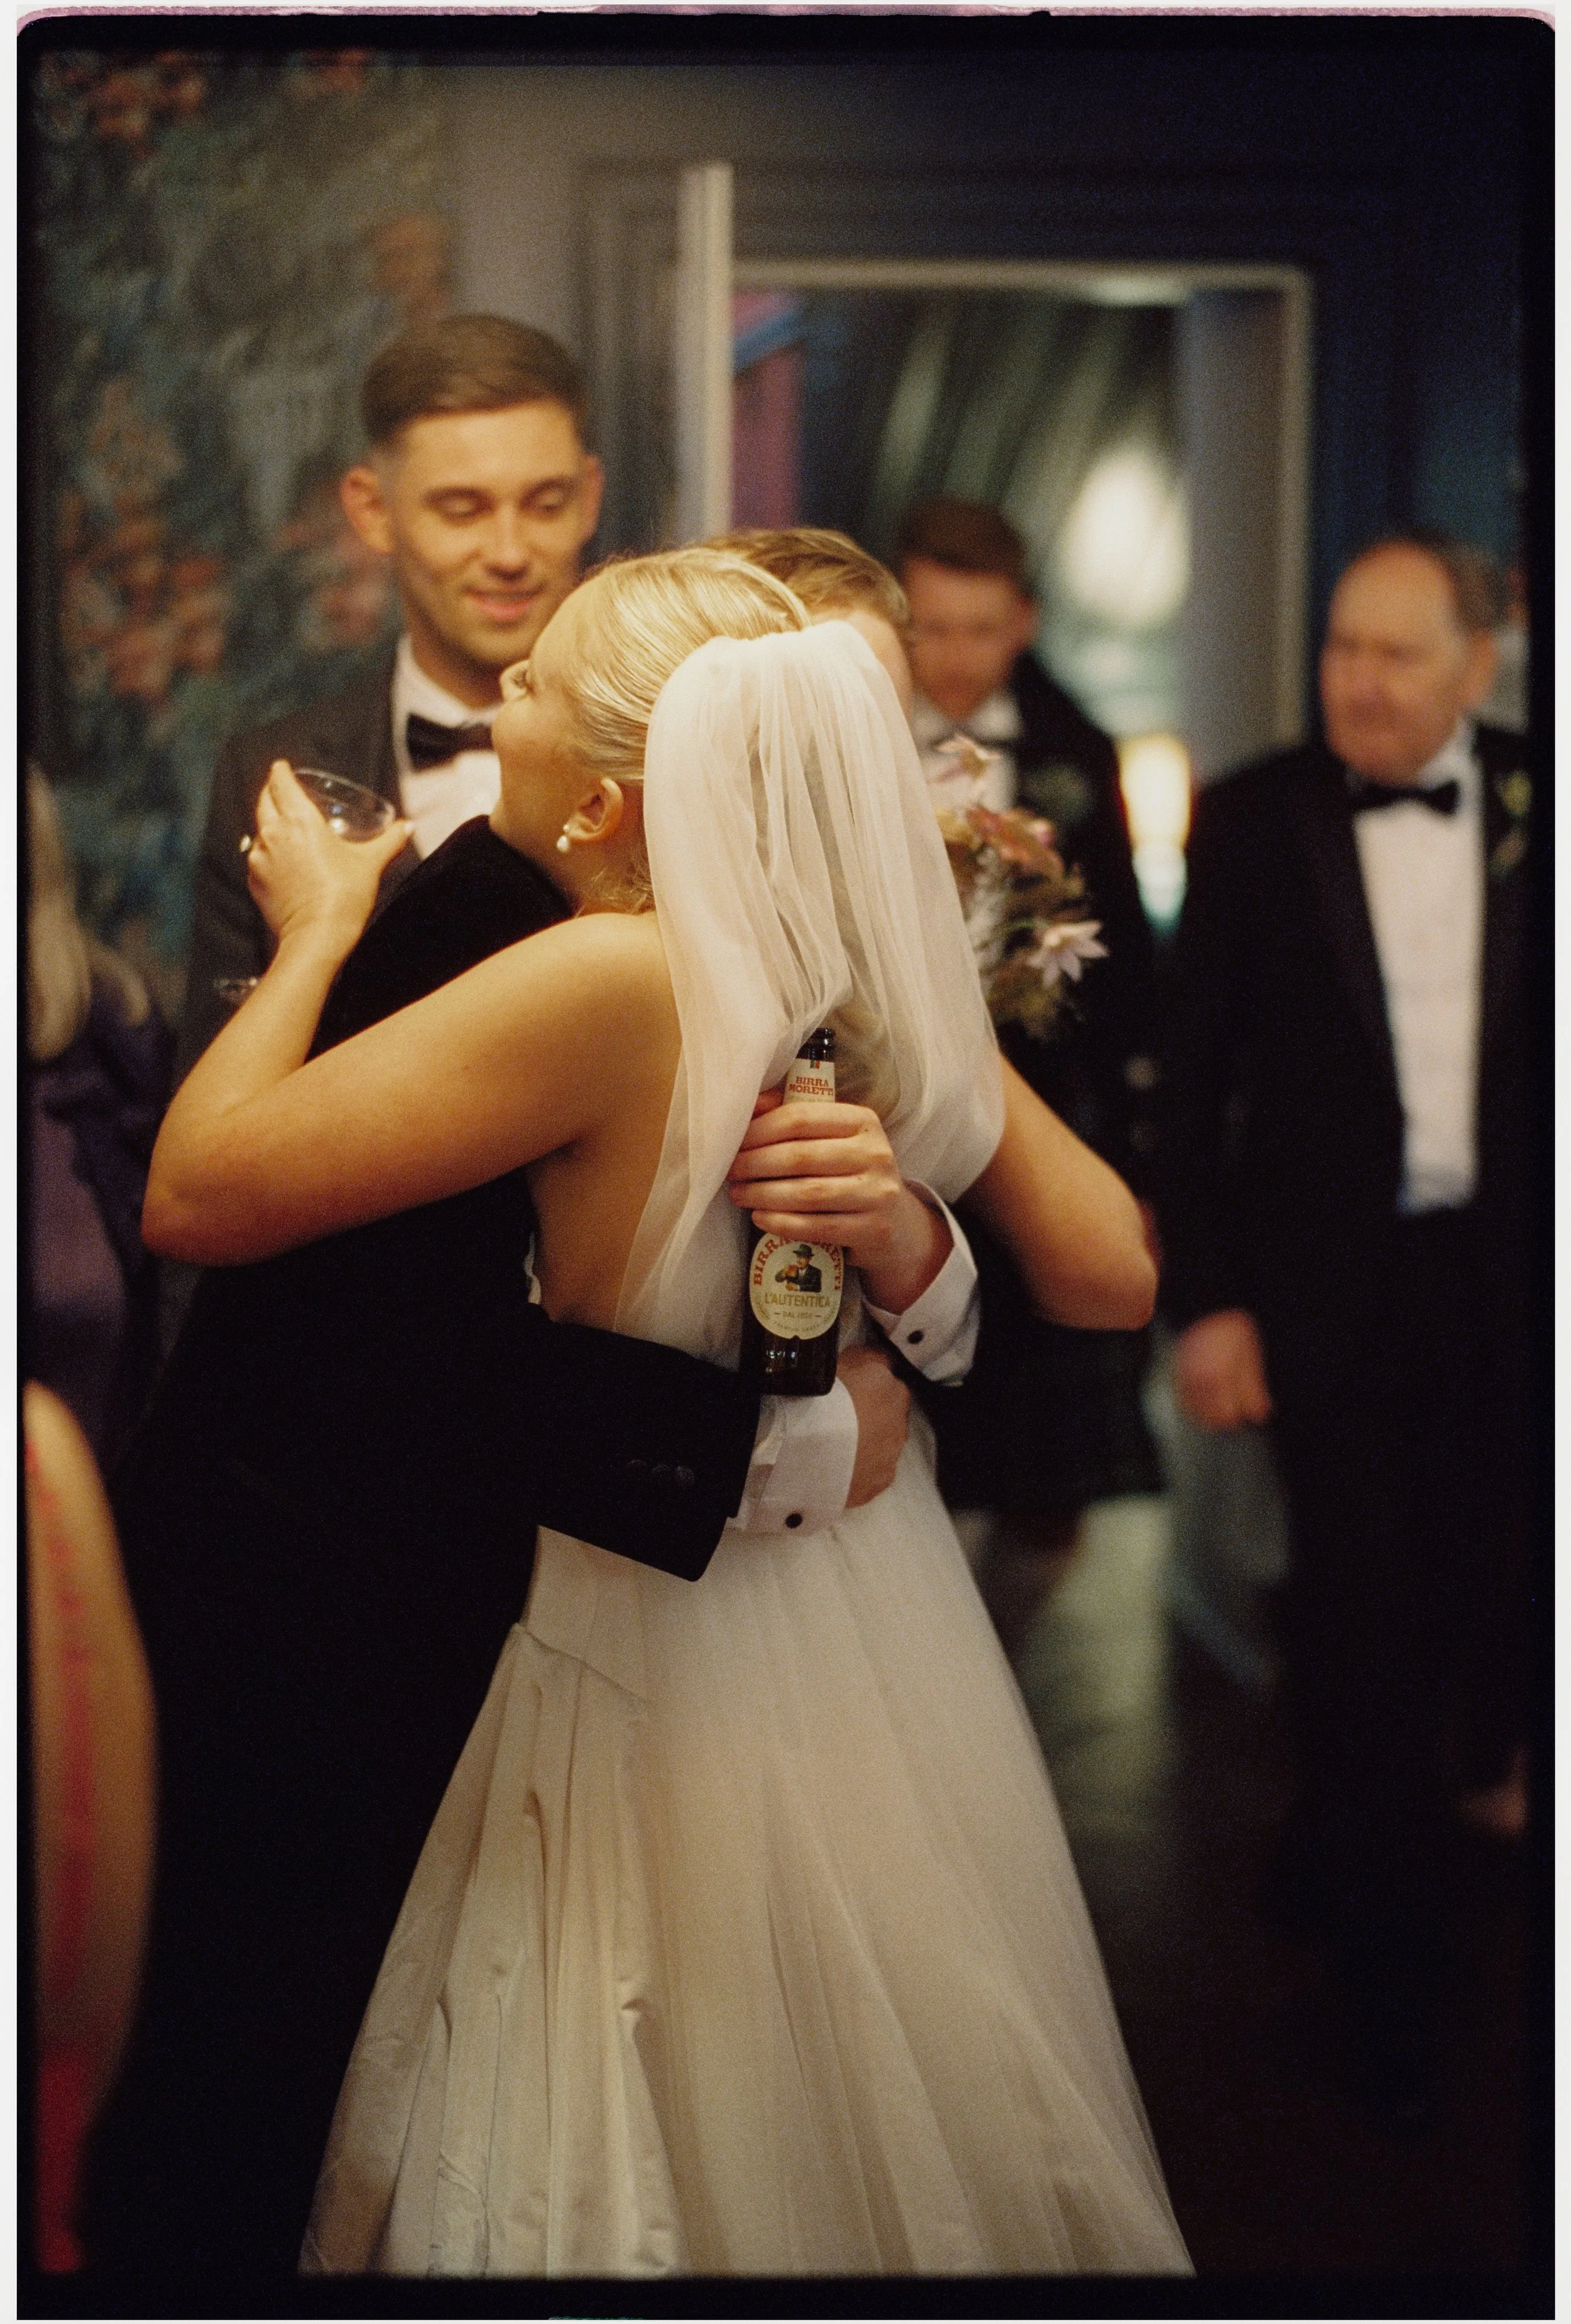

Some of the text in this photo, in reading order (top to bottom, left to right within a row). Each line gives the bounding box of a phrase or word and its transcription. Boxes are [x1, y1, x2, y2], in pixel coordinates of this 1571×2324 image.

[796, 1076, 829, 1087] BIRRA
[788, 1083, 833, 1095] MORETTI
[764, 1291, 831, 1307] L'AUTENTICA
